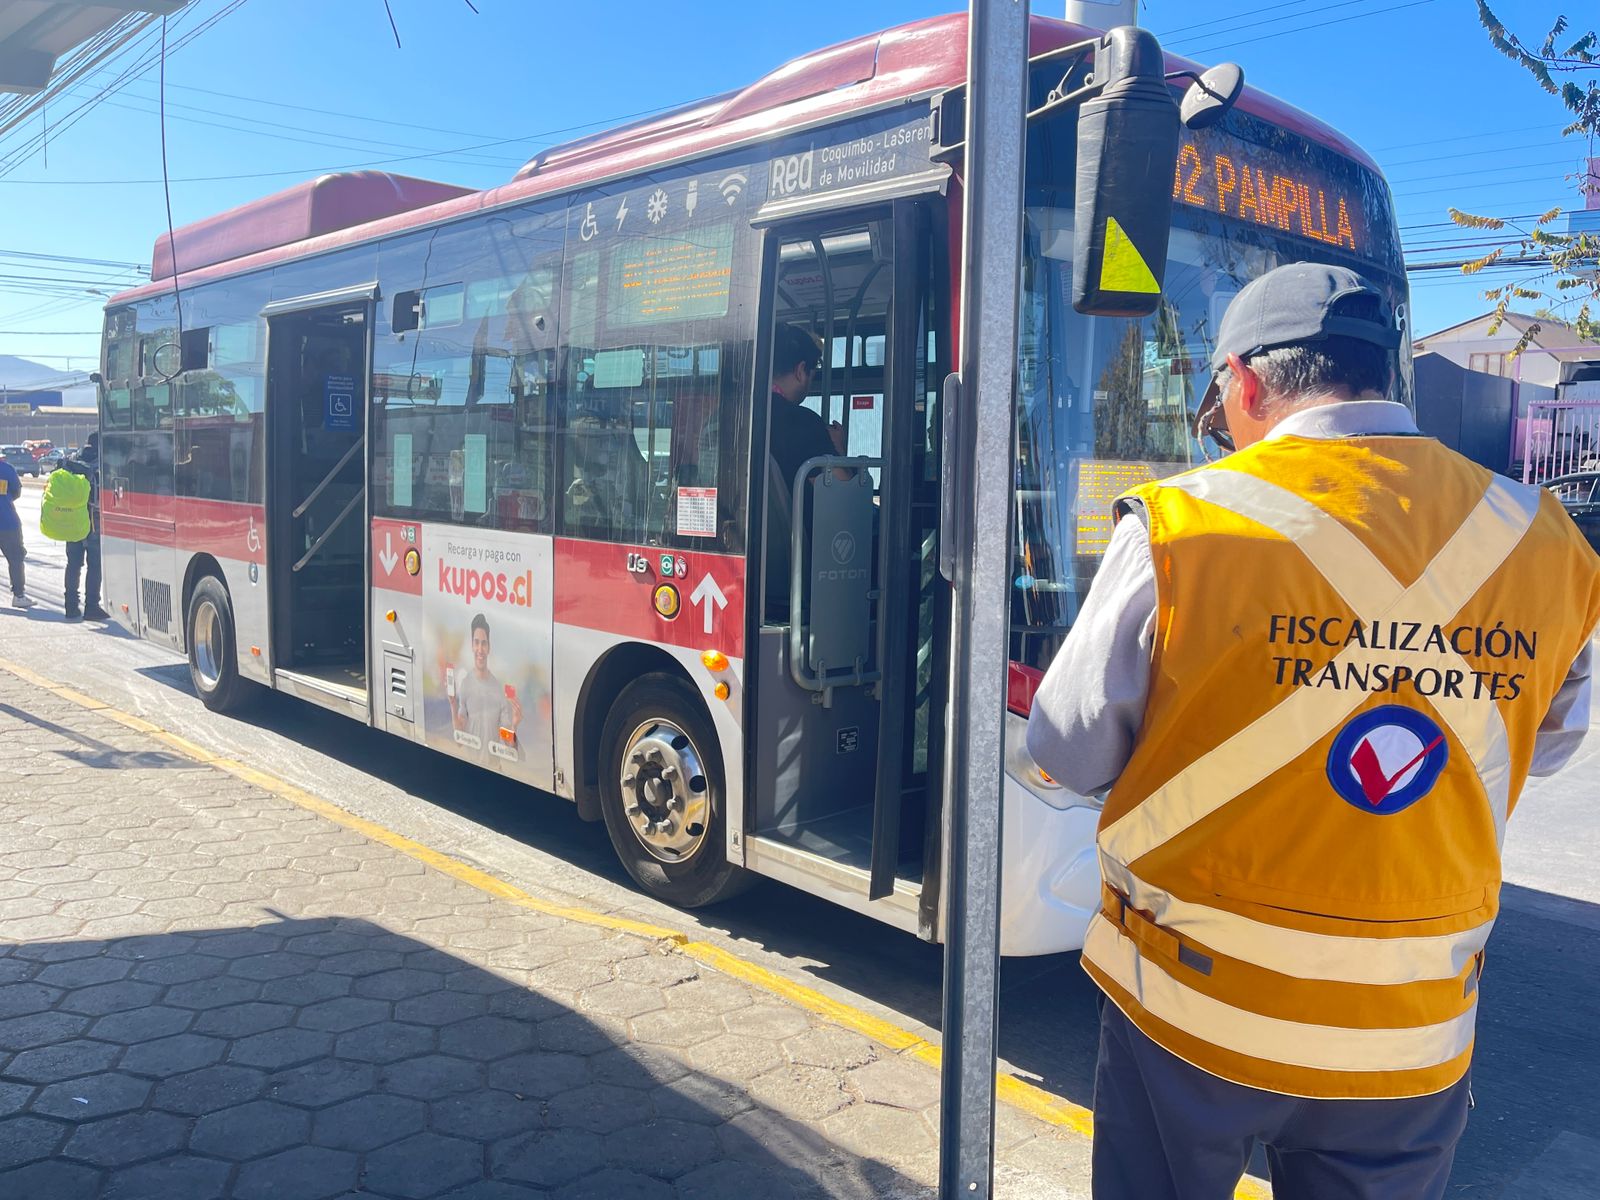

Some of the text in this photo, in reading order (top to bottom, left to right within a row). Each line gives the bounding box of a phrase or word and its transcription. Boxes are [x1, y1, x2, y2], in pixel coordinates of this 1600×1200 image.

[821, 138, 874, 164] Coquimbo
[884, 126, 930, 148] LaSeren
[771, 141, 814, 197] Red
[819, 153, 896, 186] de Movilidad
[1215, 154, 1356, 250] PAMPILLA
[447, 542, 521, 563] Recarga y paga con
[438, 557, 532, 608] kupos.cl
[1268, 614, 1537, 660] FISCALIZACIÓN
[1272, 656, 1525, 701] TRANSPORTES
